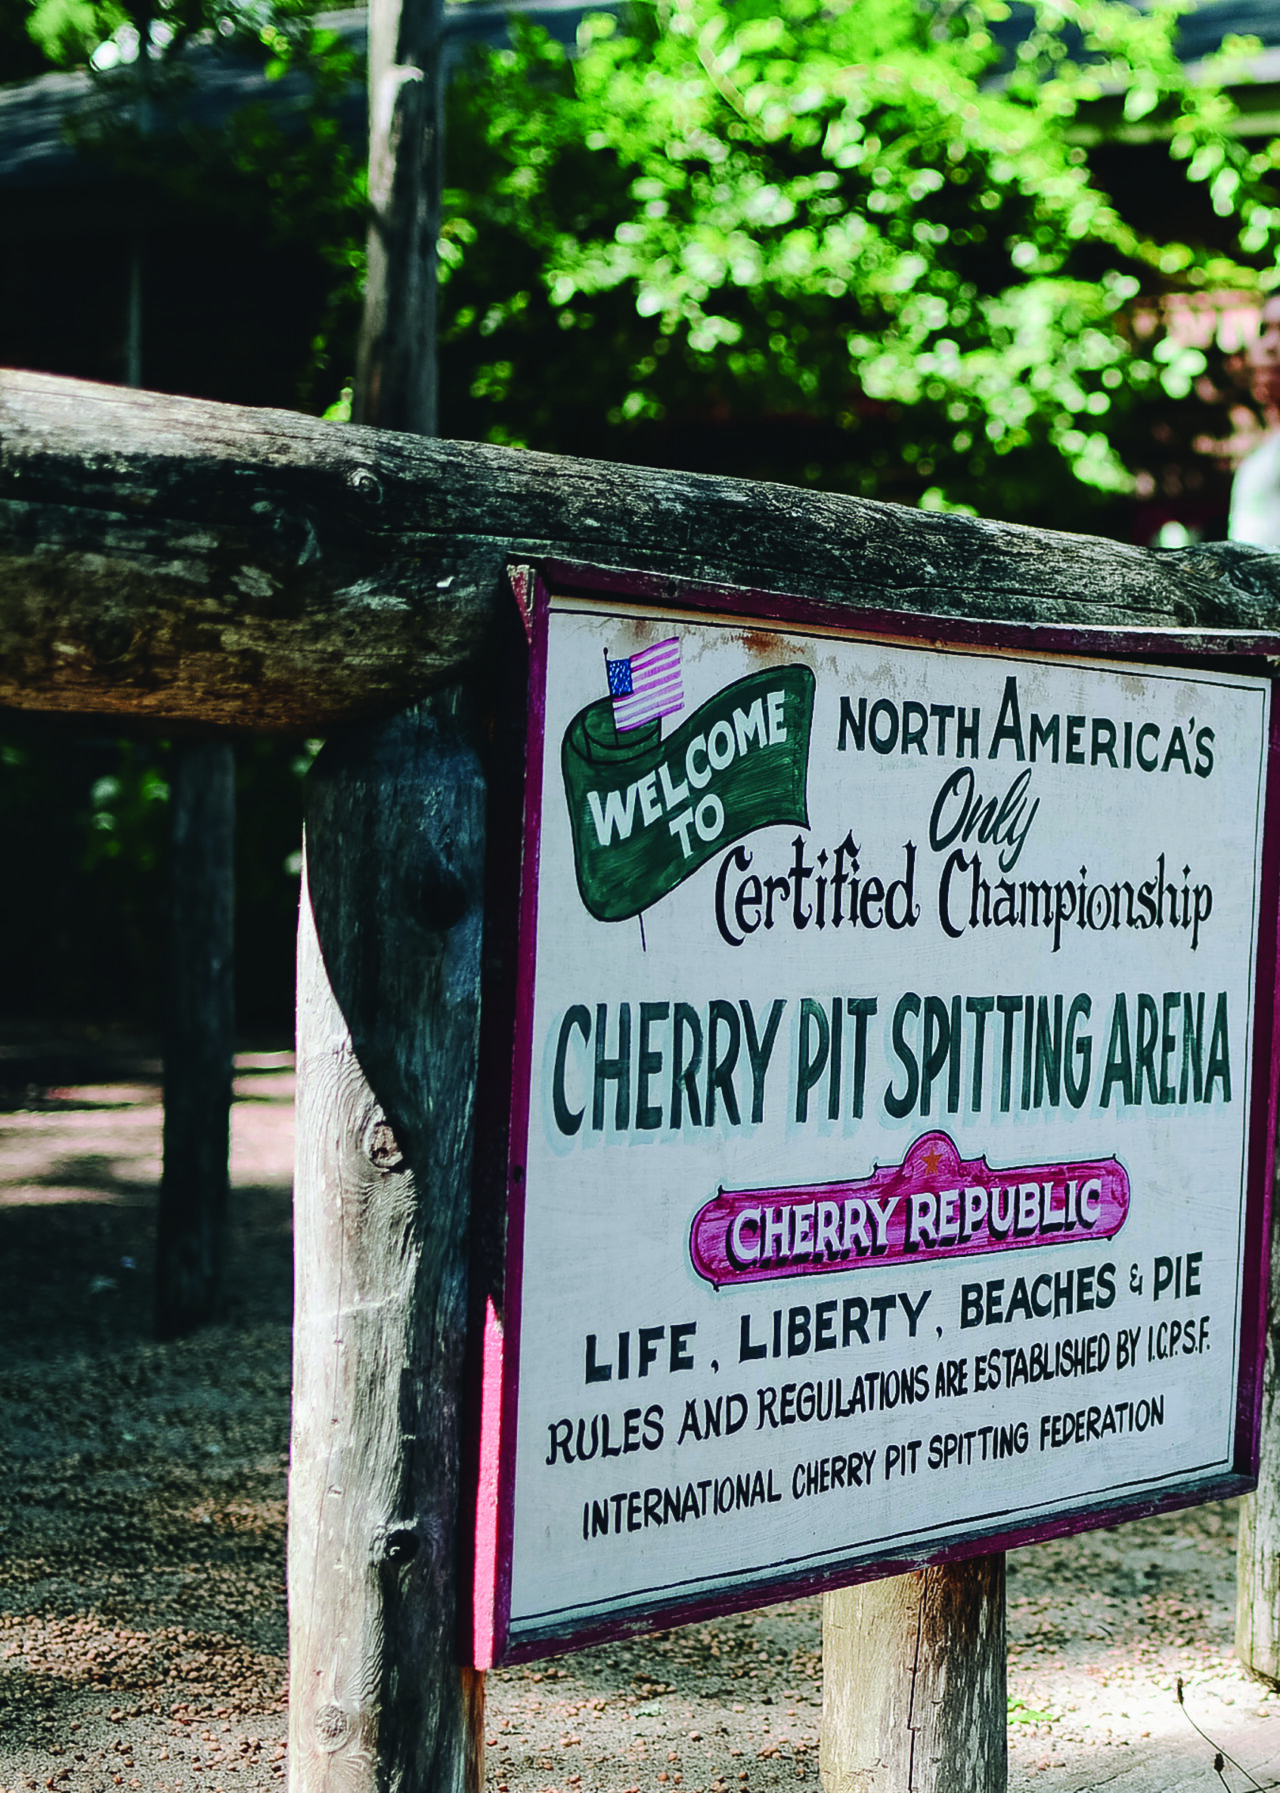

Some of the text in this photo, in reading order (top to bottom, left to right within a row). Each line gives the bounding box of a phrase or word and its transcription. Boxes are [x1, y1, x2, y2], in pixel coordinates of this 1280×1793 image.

[586, 691, 788, 847] WELCOME
[837, 676, 1215, 778] NORTH AMERICA'S
[670, 794, 725, 860] TO
[929, 766, 1040, 872] Only
[715, 829, 1213, 952] Certified Championship
[552, 991, 1232, 1135] CHERRY PIT SPITTING ARENA
[730, 1179, 1102, 1270] CHERRY REPUBLIC
[960, 1263, 1117, 1329] BEACHES
[1128, 1264, 1143, 1295] &
[1153, 1251, 1203, 1301] PIE
[546, 1404, 664, 1465] RULES
[678, 1392, 748, 1446] AND
[756, 1369, 930, 1431] REGULATIONS
[935, 1358, 968, 1398] ARE
[974, 1335, 1110, 1392] ESTABLISHED
[1115, 1328, 1140, 1369] BY
[582, 1395, 1165, 1541] INTERNATIONAL CHERRY PIT SPITTING FEDERATION
